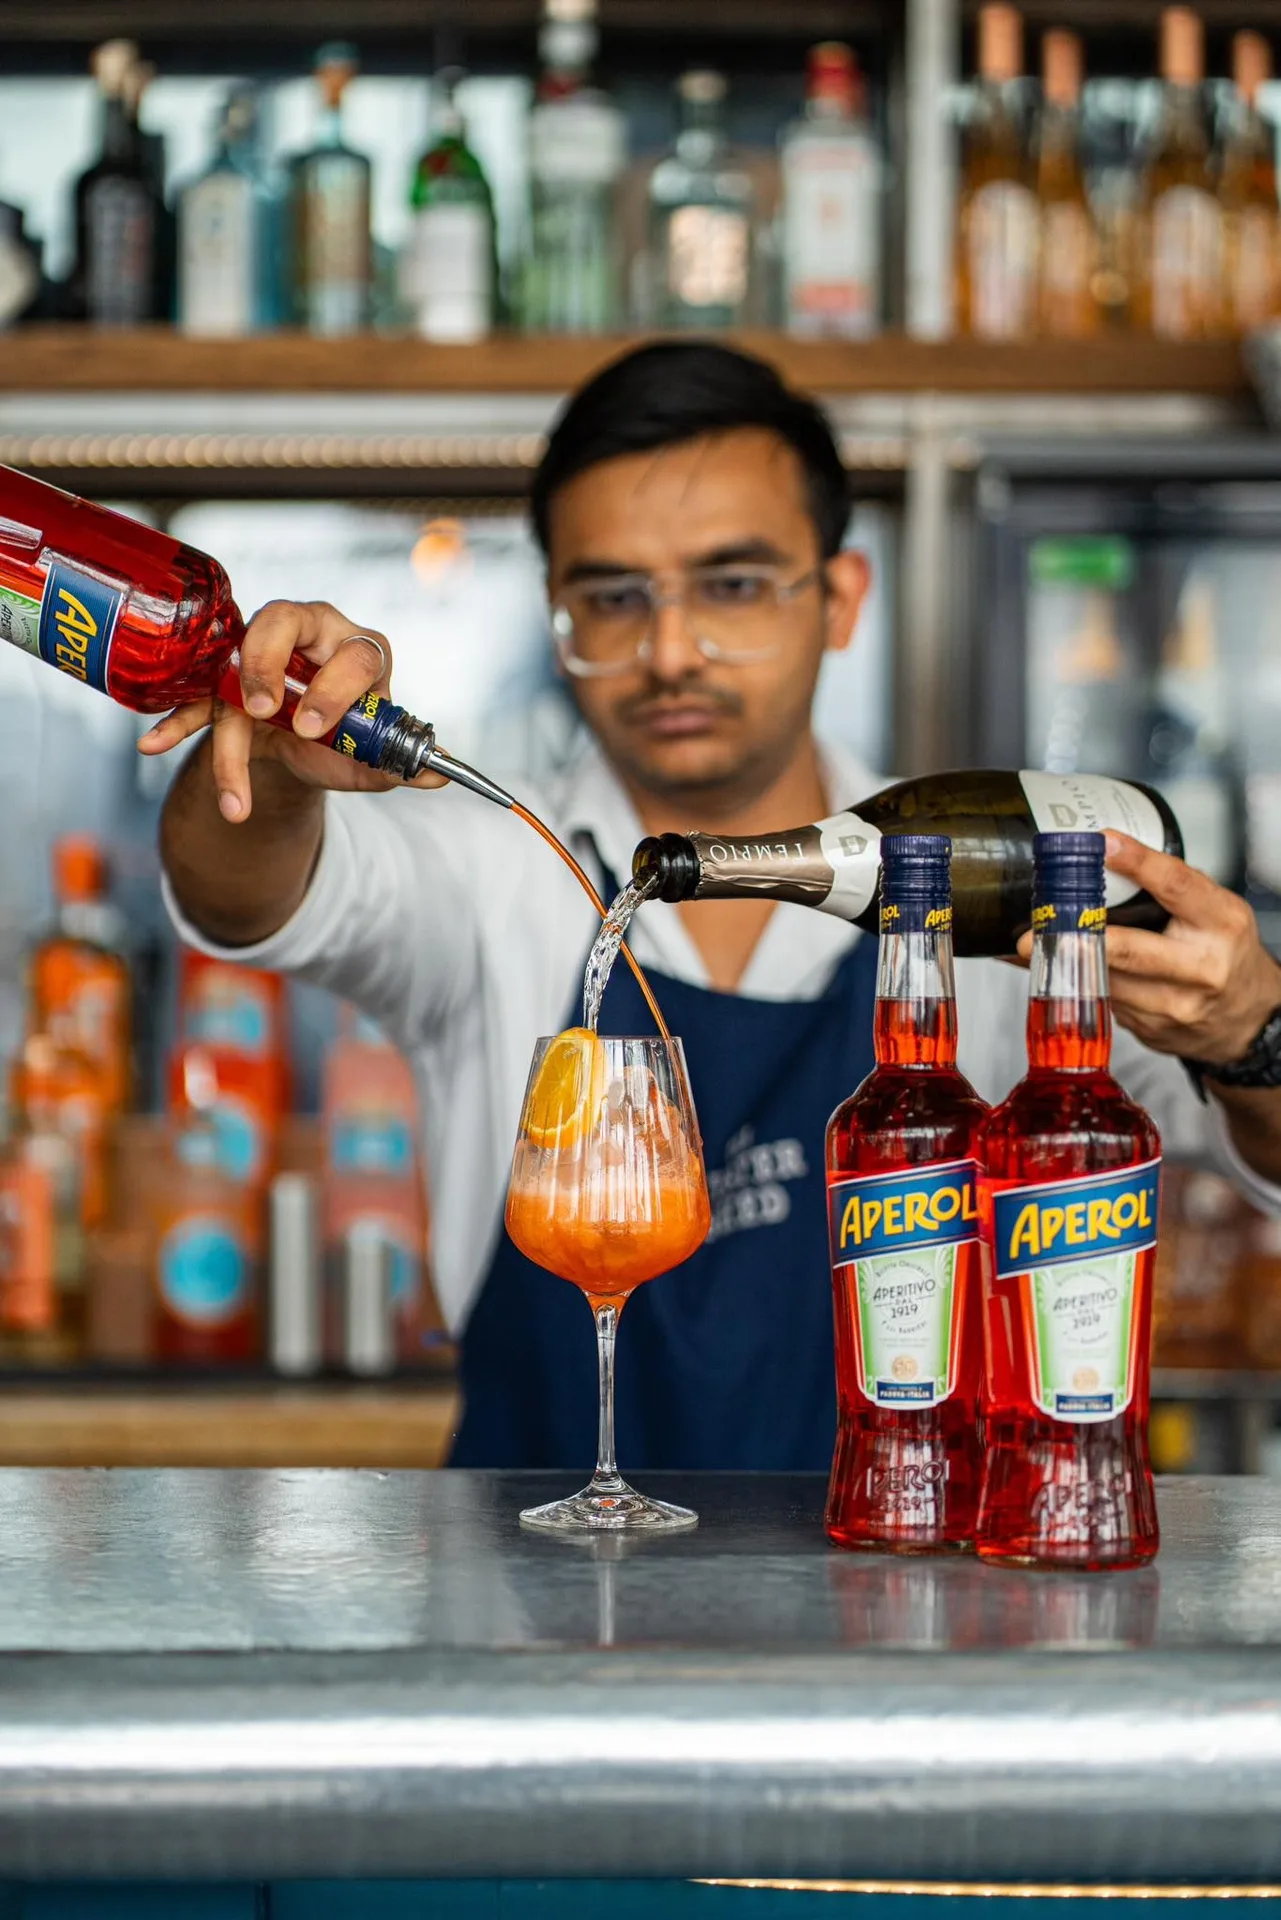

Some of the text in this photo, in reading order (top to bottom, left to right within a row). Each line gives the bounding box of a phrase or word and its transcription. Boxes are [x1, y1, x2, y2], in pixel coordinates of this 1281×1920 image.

[709, 843, 809, 863] TEMPIO
[840, 1183, 979, 1249] APEROL
[1009, 1187, 1153, 1260] APEROL
[873, 1279, 936, 1301] APERITIVO
[891, 1304, 918, 1318] 1919
